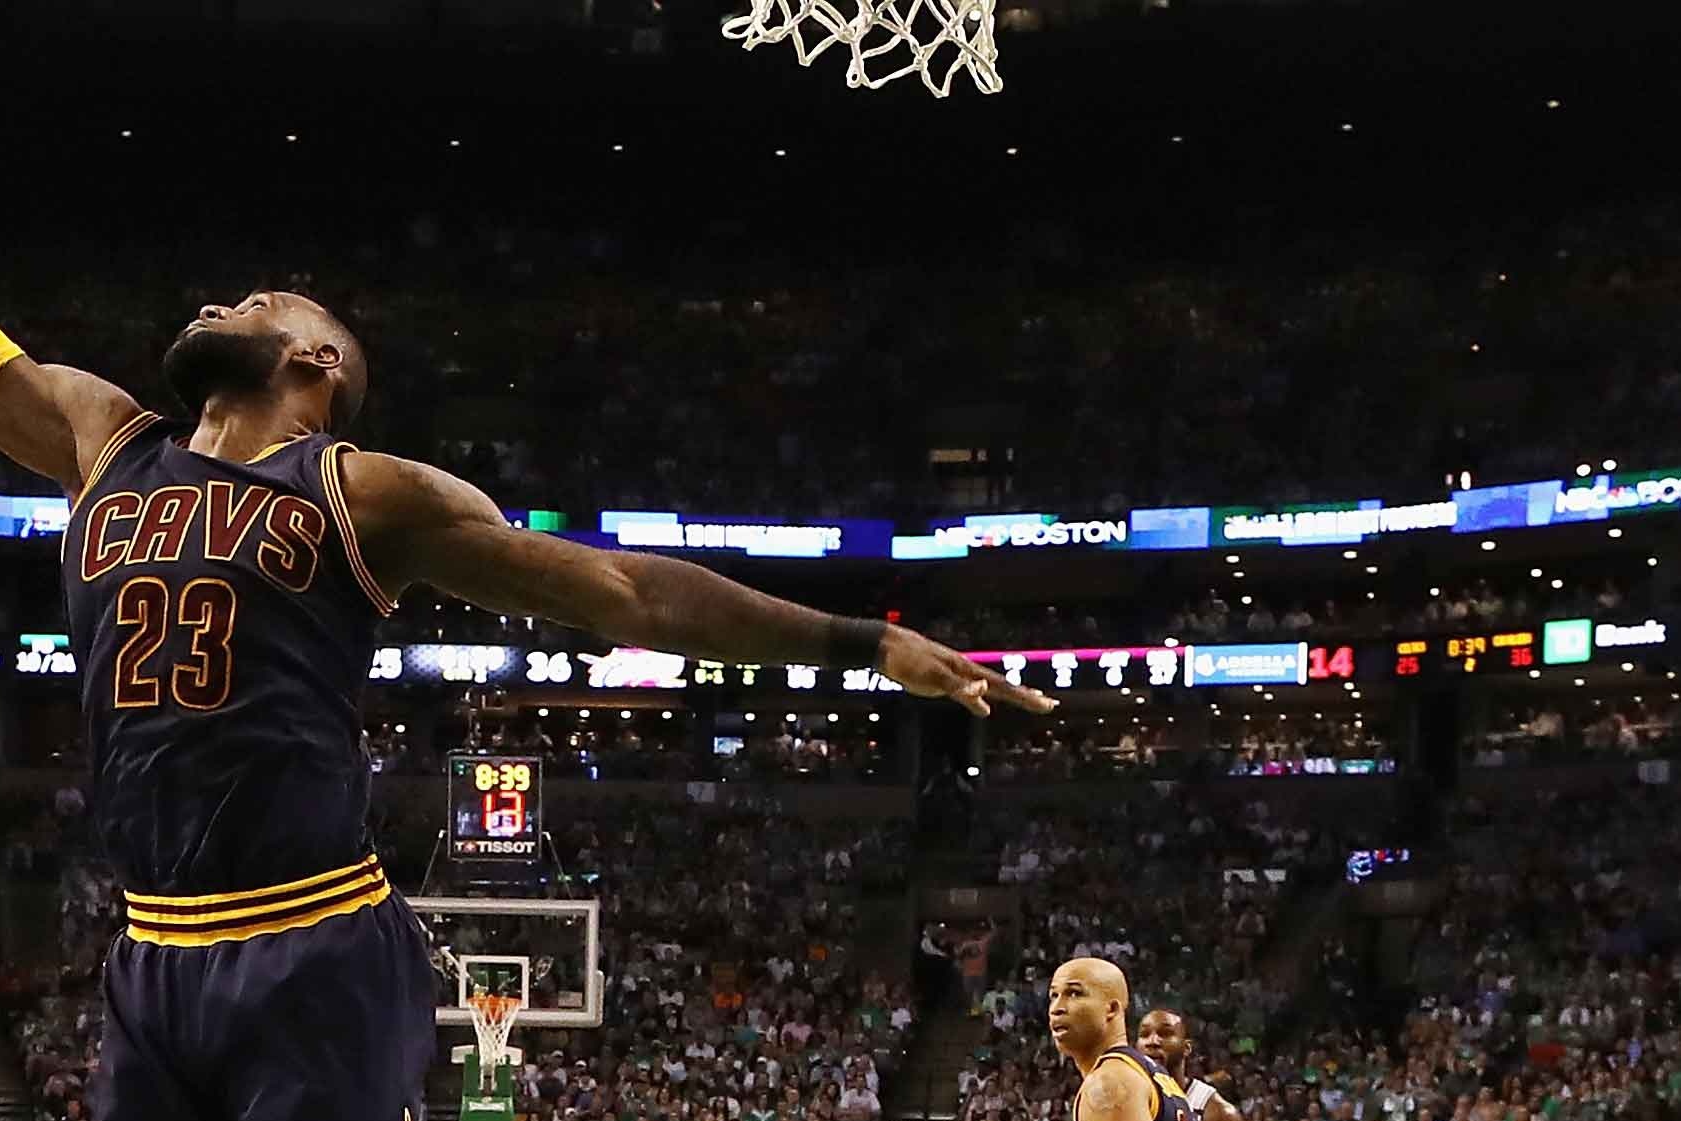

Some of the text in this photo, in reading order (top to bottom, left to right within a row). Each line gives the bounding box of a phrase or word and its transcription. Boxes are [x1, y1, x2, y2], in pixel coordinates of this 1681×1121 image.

[81, 480, 325, 593] CAVS
[1011, 520, 1127, 547] BOSTON
[114, 576, 236, 710] 23
[526, 651, 572, 683] 36
[1307, 647, 1354, 678] 14
[475, 763, 531, 791] 8:39
[476, 840, 536, 854] TISSOT
